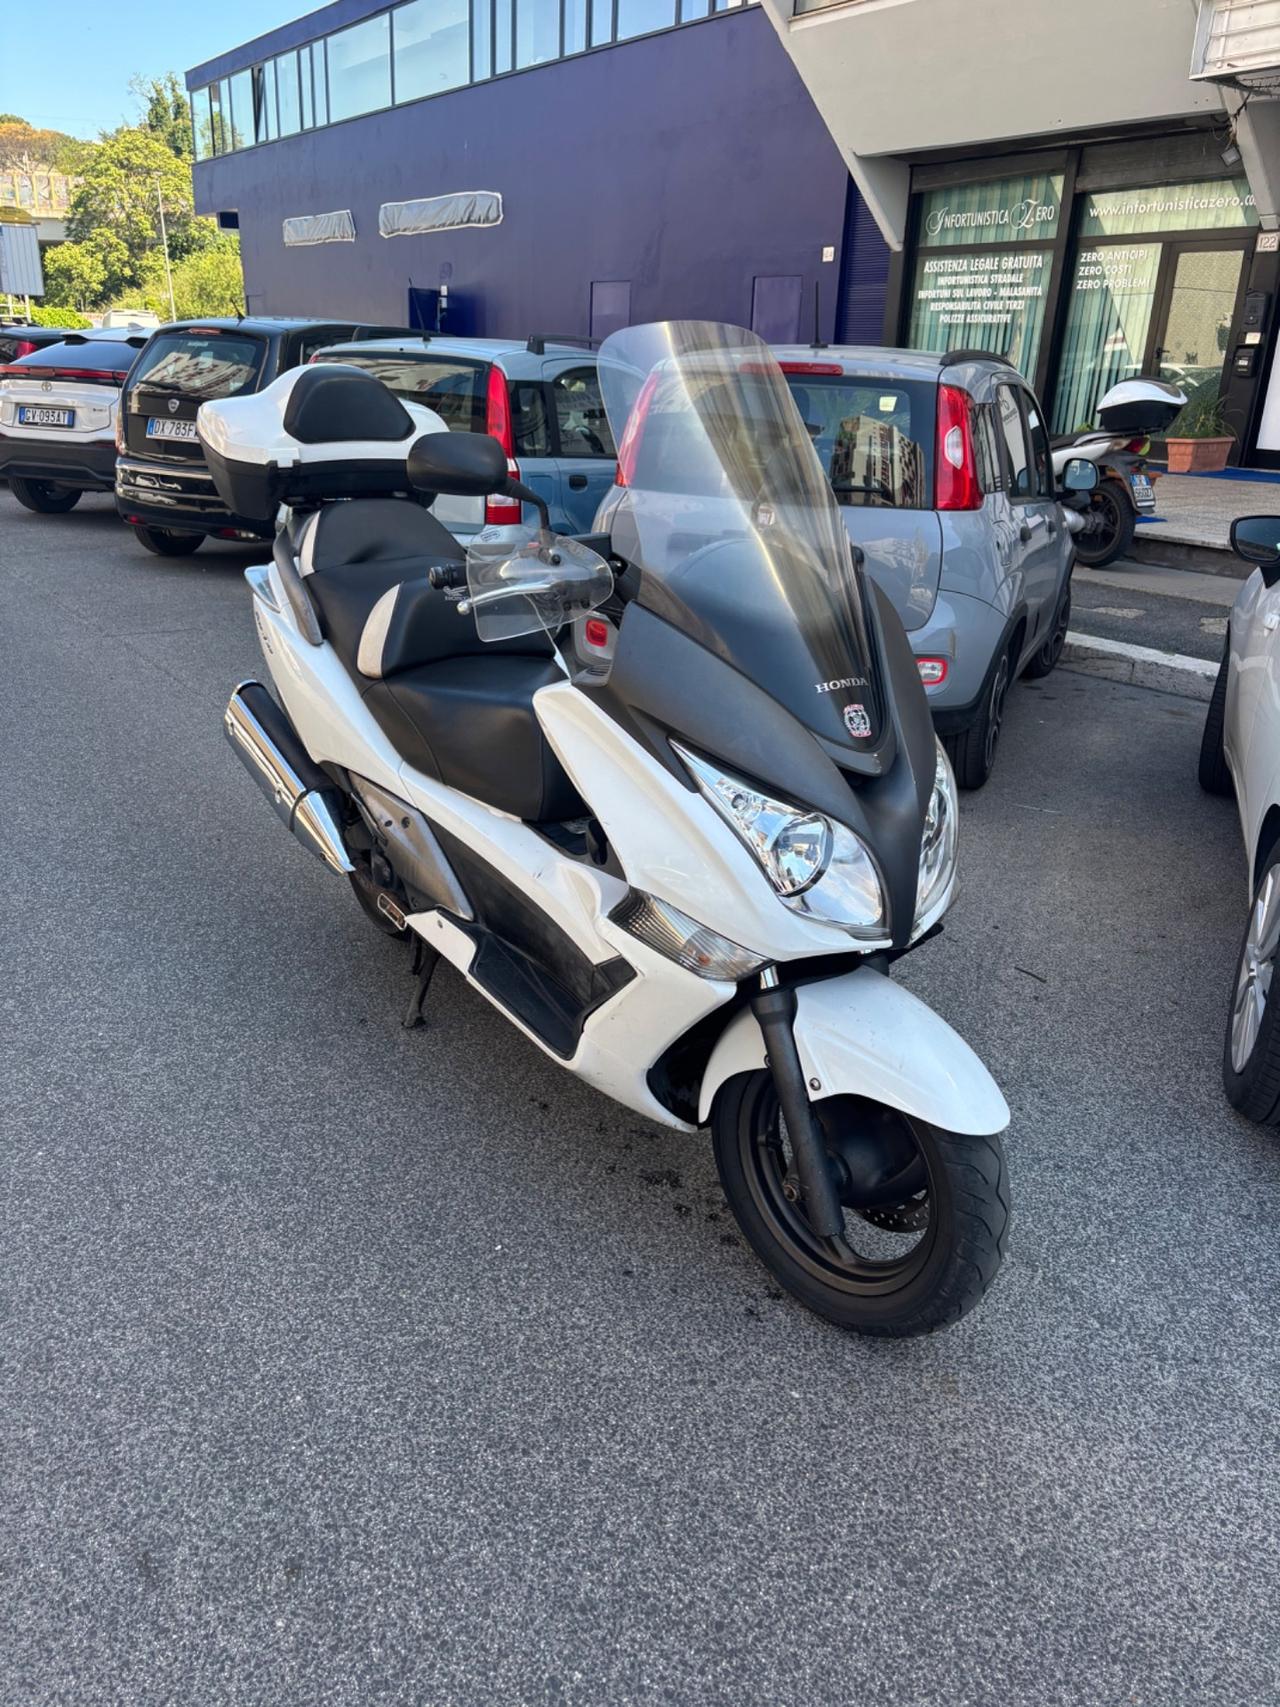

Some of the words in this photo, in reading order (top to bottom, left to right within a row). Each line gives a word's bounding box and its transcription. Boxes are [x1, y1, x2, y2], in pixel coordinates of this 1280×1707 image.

[1089, 193, 1257, 217] www.infortunisticazero.co
[1260, 236, 1277, 249] 122
[1081, 252, 1104, 263] ZERO
[1107, 249, 1149, 261] ANTICIPI
[924, 259, 968, 273] ASSISTENZA
[970, 257, 999, 271] LEGALE
[1001, 255, 1043, 269] GRATUITA
[1078, 266, 1102, 277] ZERO
[1104, 264, 1132, 275] COSTI
[937, 275, 988, 286] INFORTUNISTICA
[990, 273, 1023, 284] STRADALE
[1076, 279, 1100, 291] ZERO
[1103, 277, 1150, 289] PROBLEMI
[918, 289, 951, 300] INFORTUNI
[952, 289, 964, 299] SUL
[966, 287, 993, 298] LAVORO
[983, 301, 1004, 310] CIVILE
[1006, 300, 1025, 310] TERZI
[940, 314, 965, 324] POLIZZE
[967, 313, 1012, 323] ASSICURATIVE
[814, 677, 870, 694] HONDA
